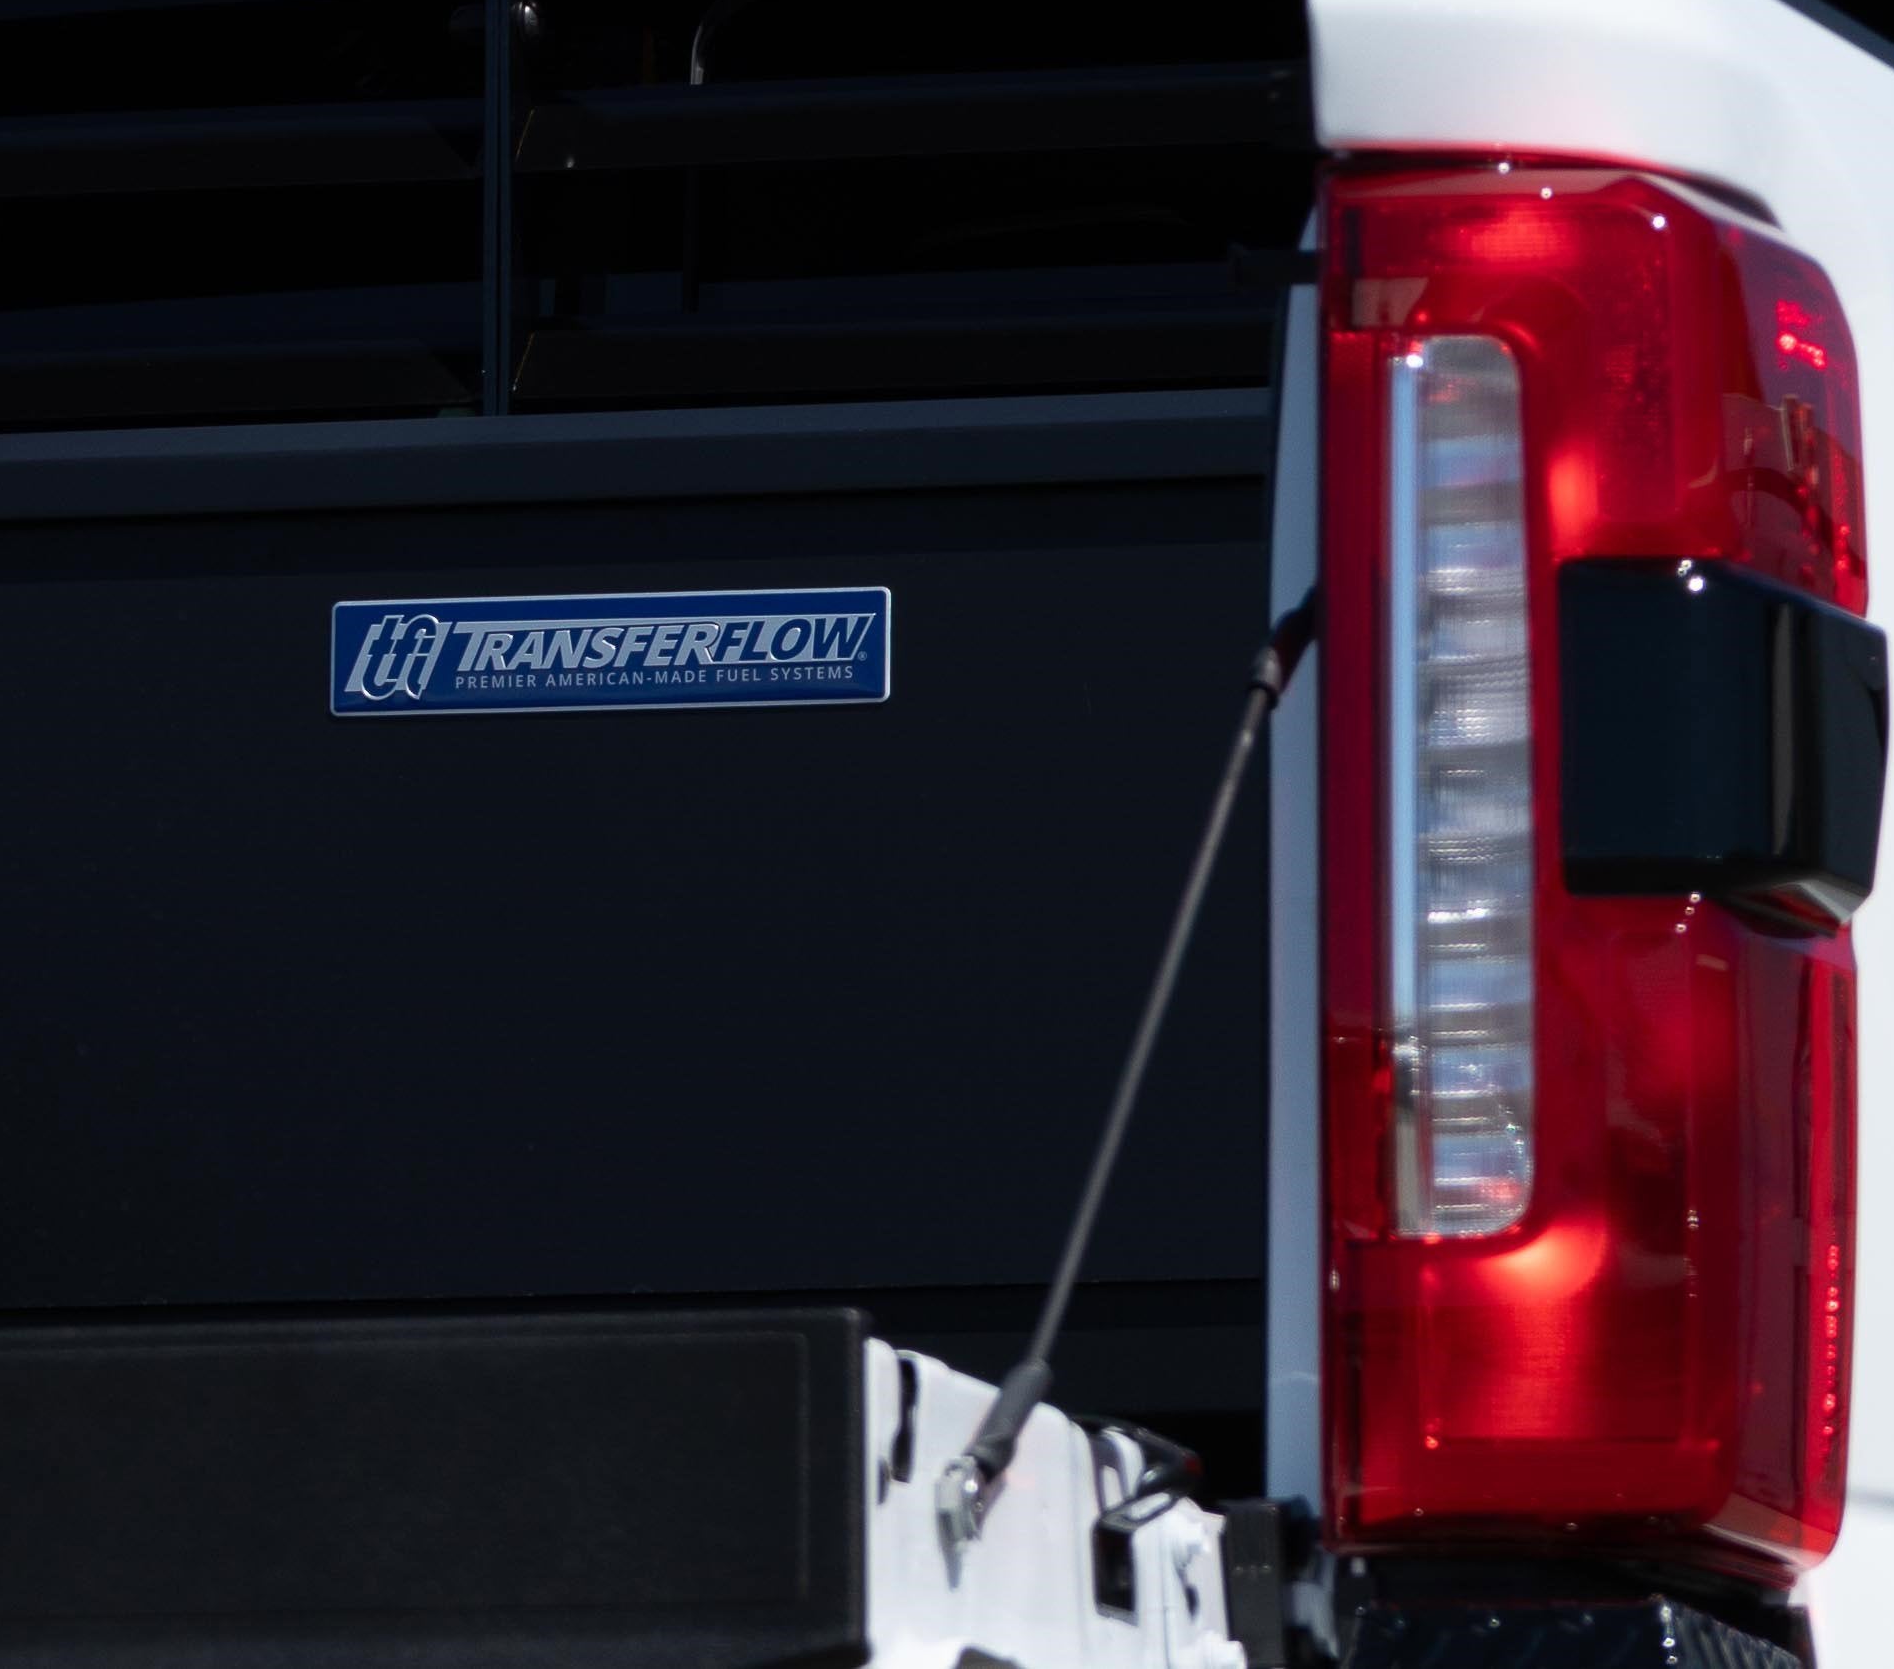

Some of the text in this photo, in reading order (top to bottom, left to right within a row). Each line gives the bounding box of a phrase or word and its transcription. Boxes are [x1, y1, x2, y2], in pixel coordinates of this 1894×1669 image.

[454, 664, 854, 690] PREMIER AMERICAN-MADE FUEL SYSTEMS
